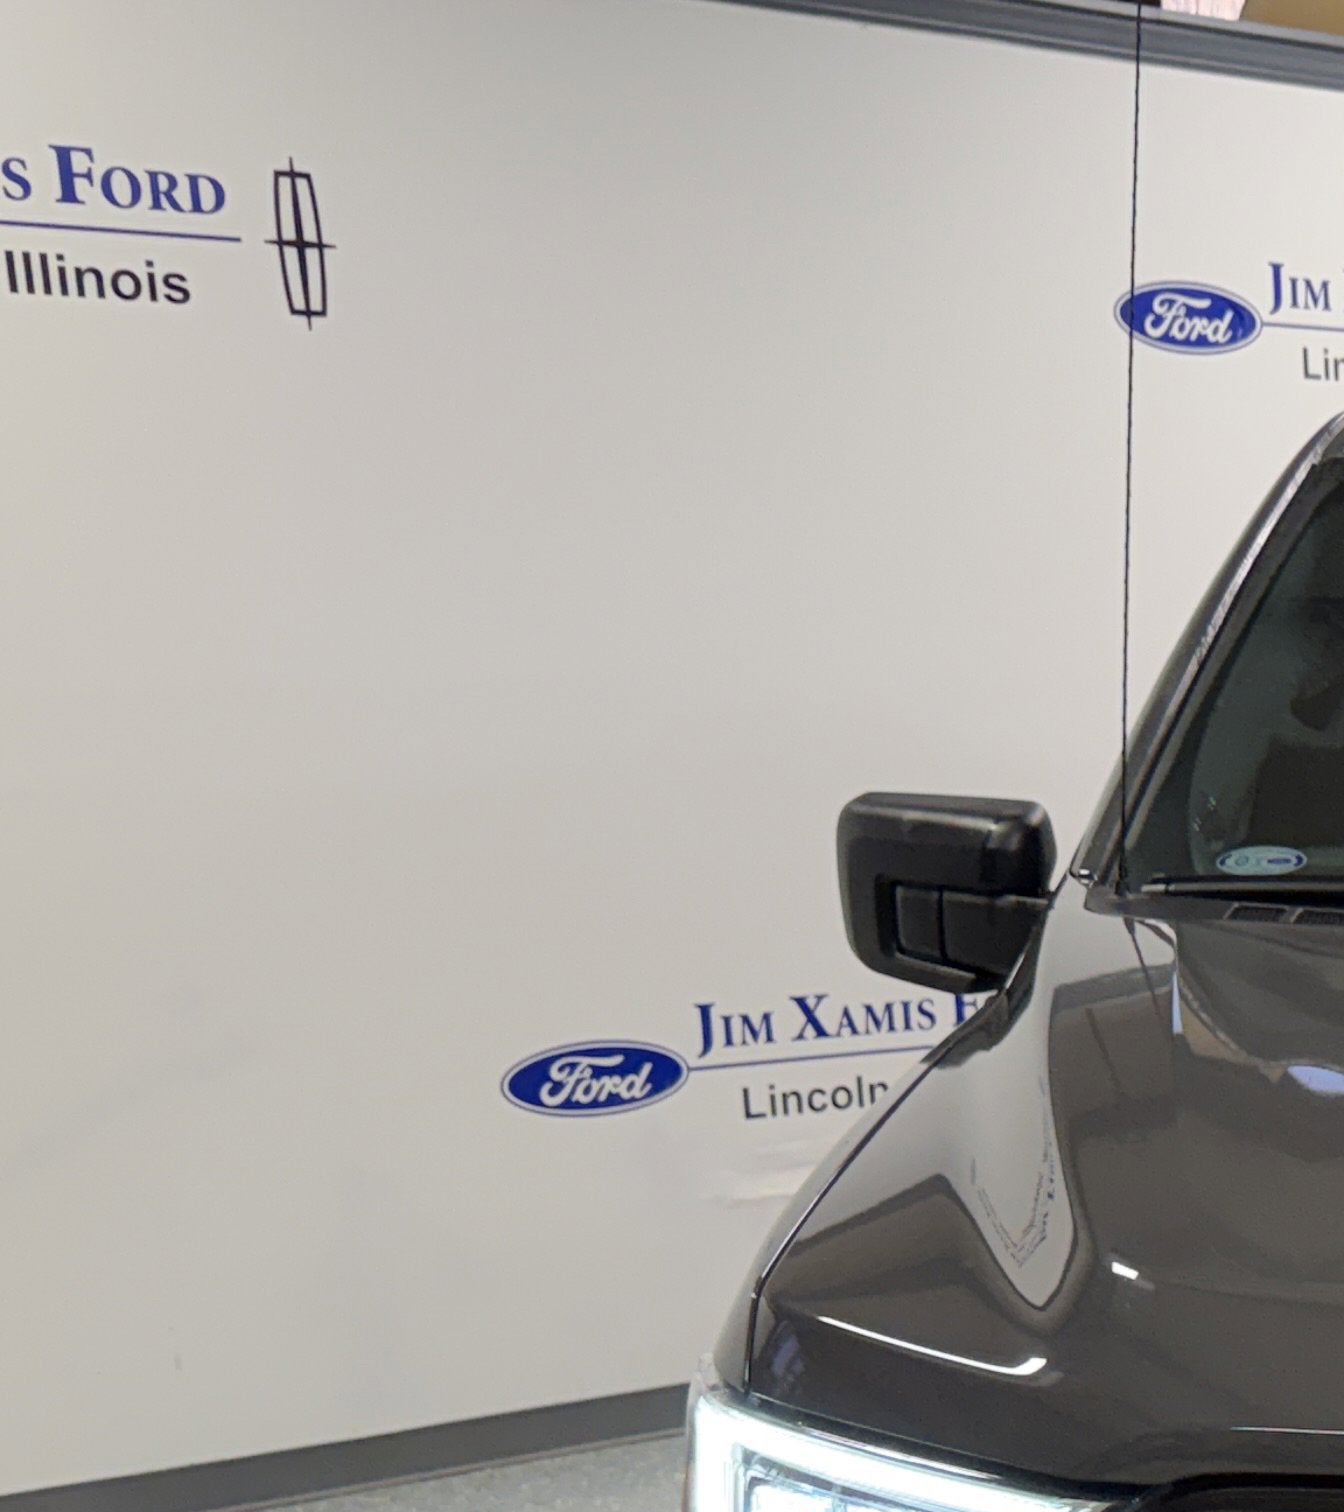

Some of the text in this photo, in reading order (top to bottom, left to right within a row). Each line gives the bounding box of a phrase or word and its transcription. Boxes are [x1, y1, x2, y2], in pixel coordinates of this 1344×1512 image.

[48, 144, 226, 215] FORD
[5, 250, 191, 304] Illinois
[1268, 262, 1331, 315] JIM
[1144, 292, 1234, 343] Ford
[694, 1003, 775, 1058] JIM
[789, 994, 937, 1041] XAMIS
[539, 1054, 653, 1107] Ford
